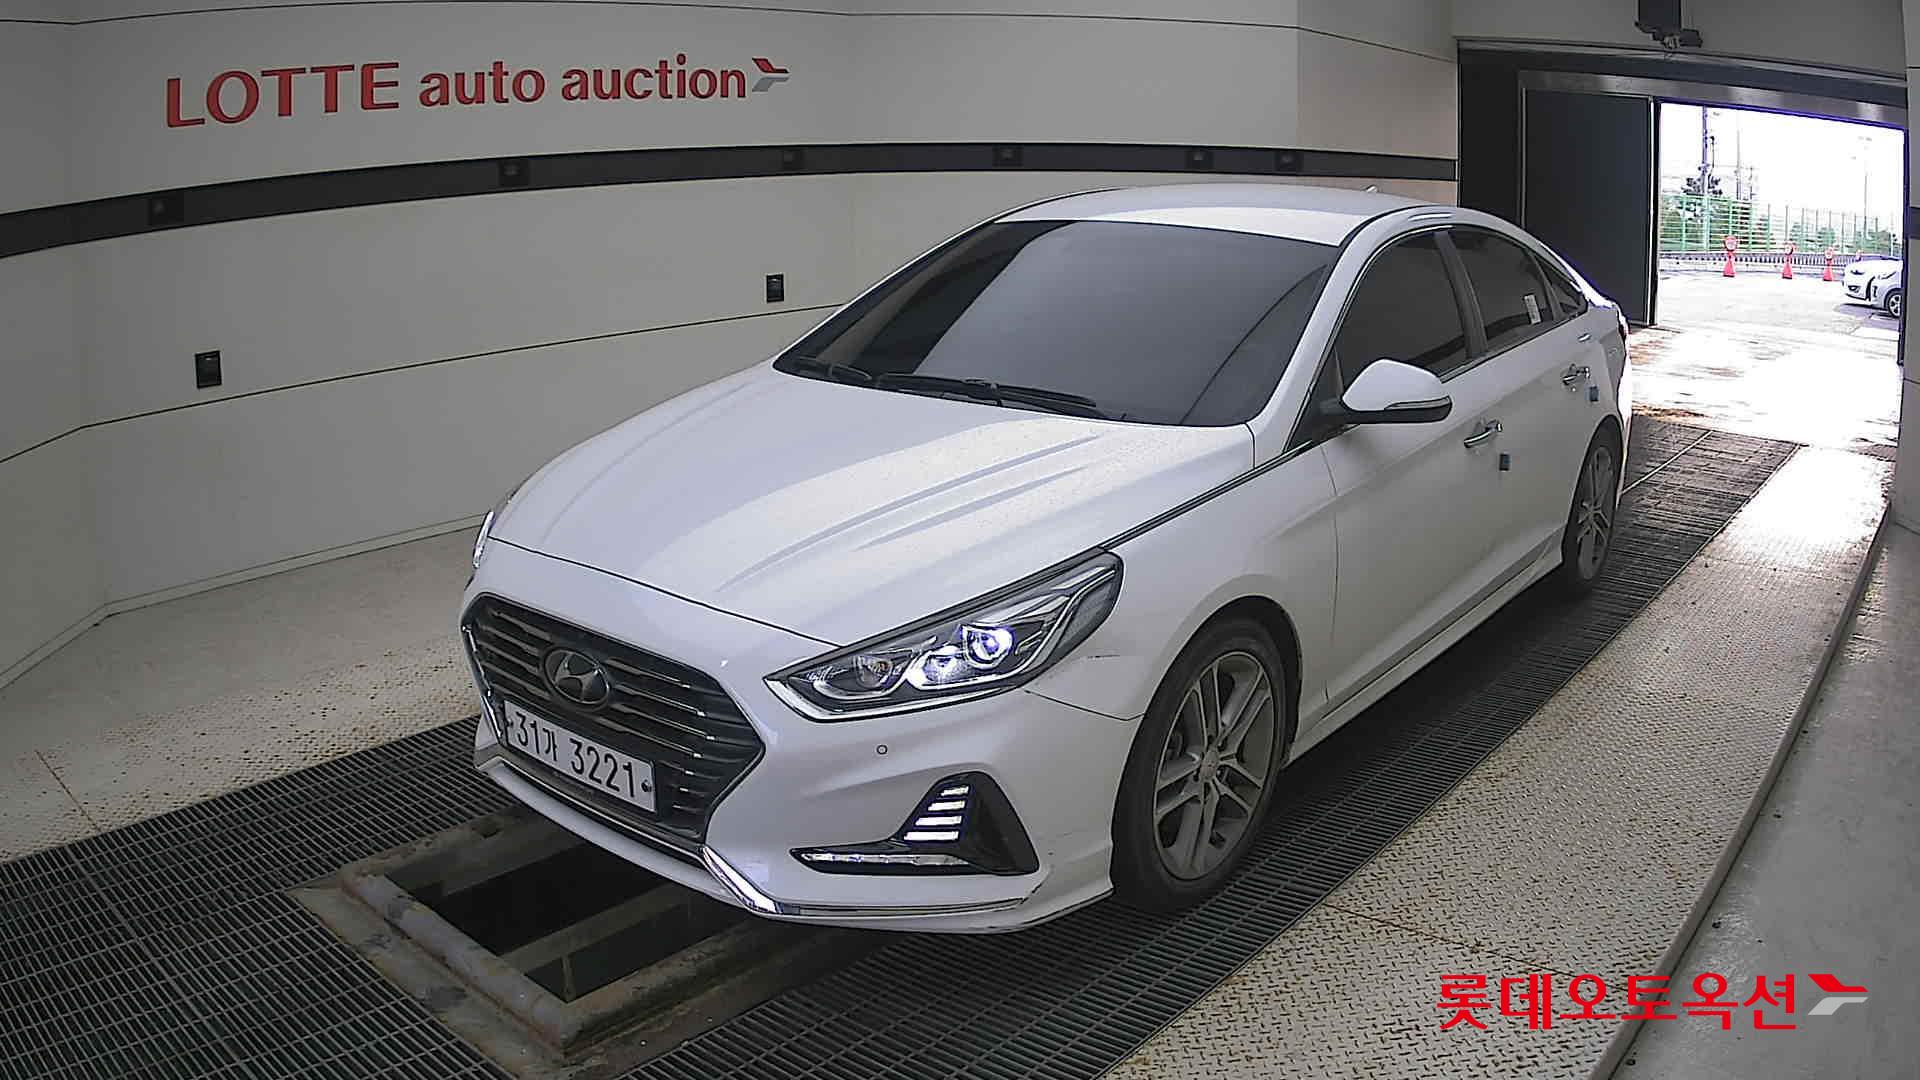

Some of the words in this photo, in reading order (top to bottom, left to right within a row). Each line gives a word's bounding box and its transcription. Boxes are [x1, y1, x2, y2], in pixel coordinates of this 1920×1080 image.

[166, 61, 400, 128] LOTTE
[419, 60, 546, 107] auto
[560, 53, 748, 101] auction
[515, 711, 558, 762] 31가
[568, 738, 635, 798] 3221
